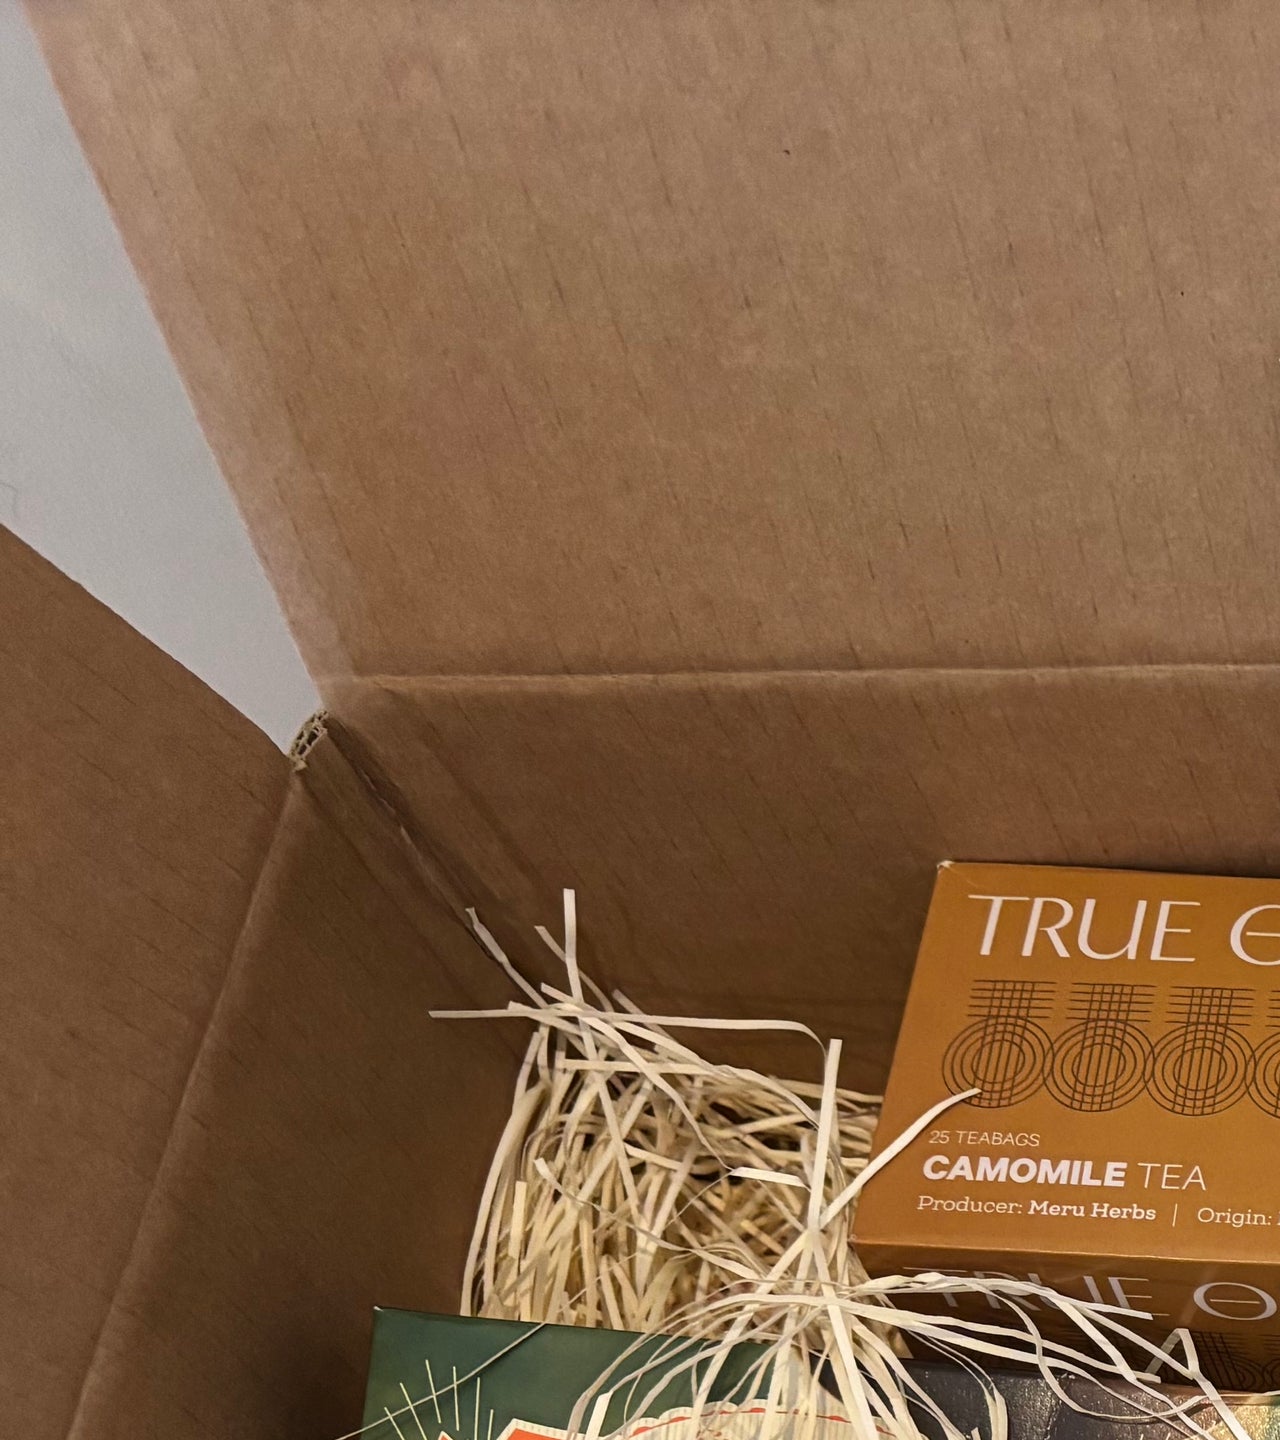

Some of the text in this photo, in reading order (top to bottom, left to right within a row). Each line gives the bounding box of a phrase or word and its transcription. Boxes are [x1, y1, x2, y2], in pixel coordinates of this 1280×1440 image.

[968, 894, 1201, 962] TRUE
[929, 1130, 1040, 1147] 25 TEABAGS
[922, 1155, 1207, 1190] CAMOMILE TEA
[917, 1195, 1156, 1220] Producer: Meru Herbs
[1197, 1207, 1271, 1227] Origin:
